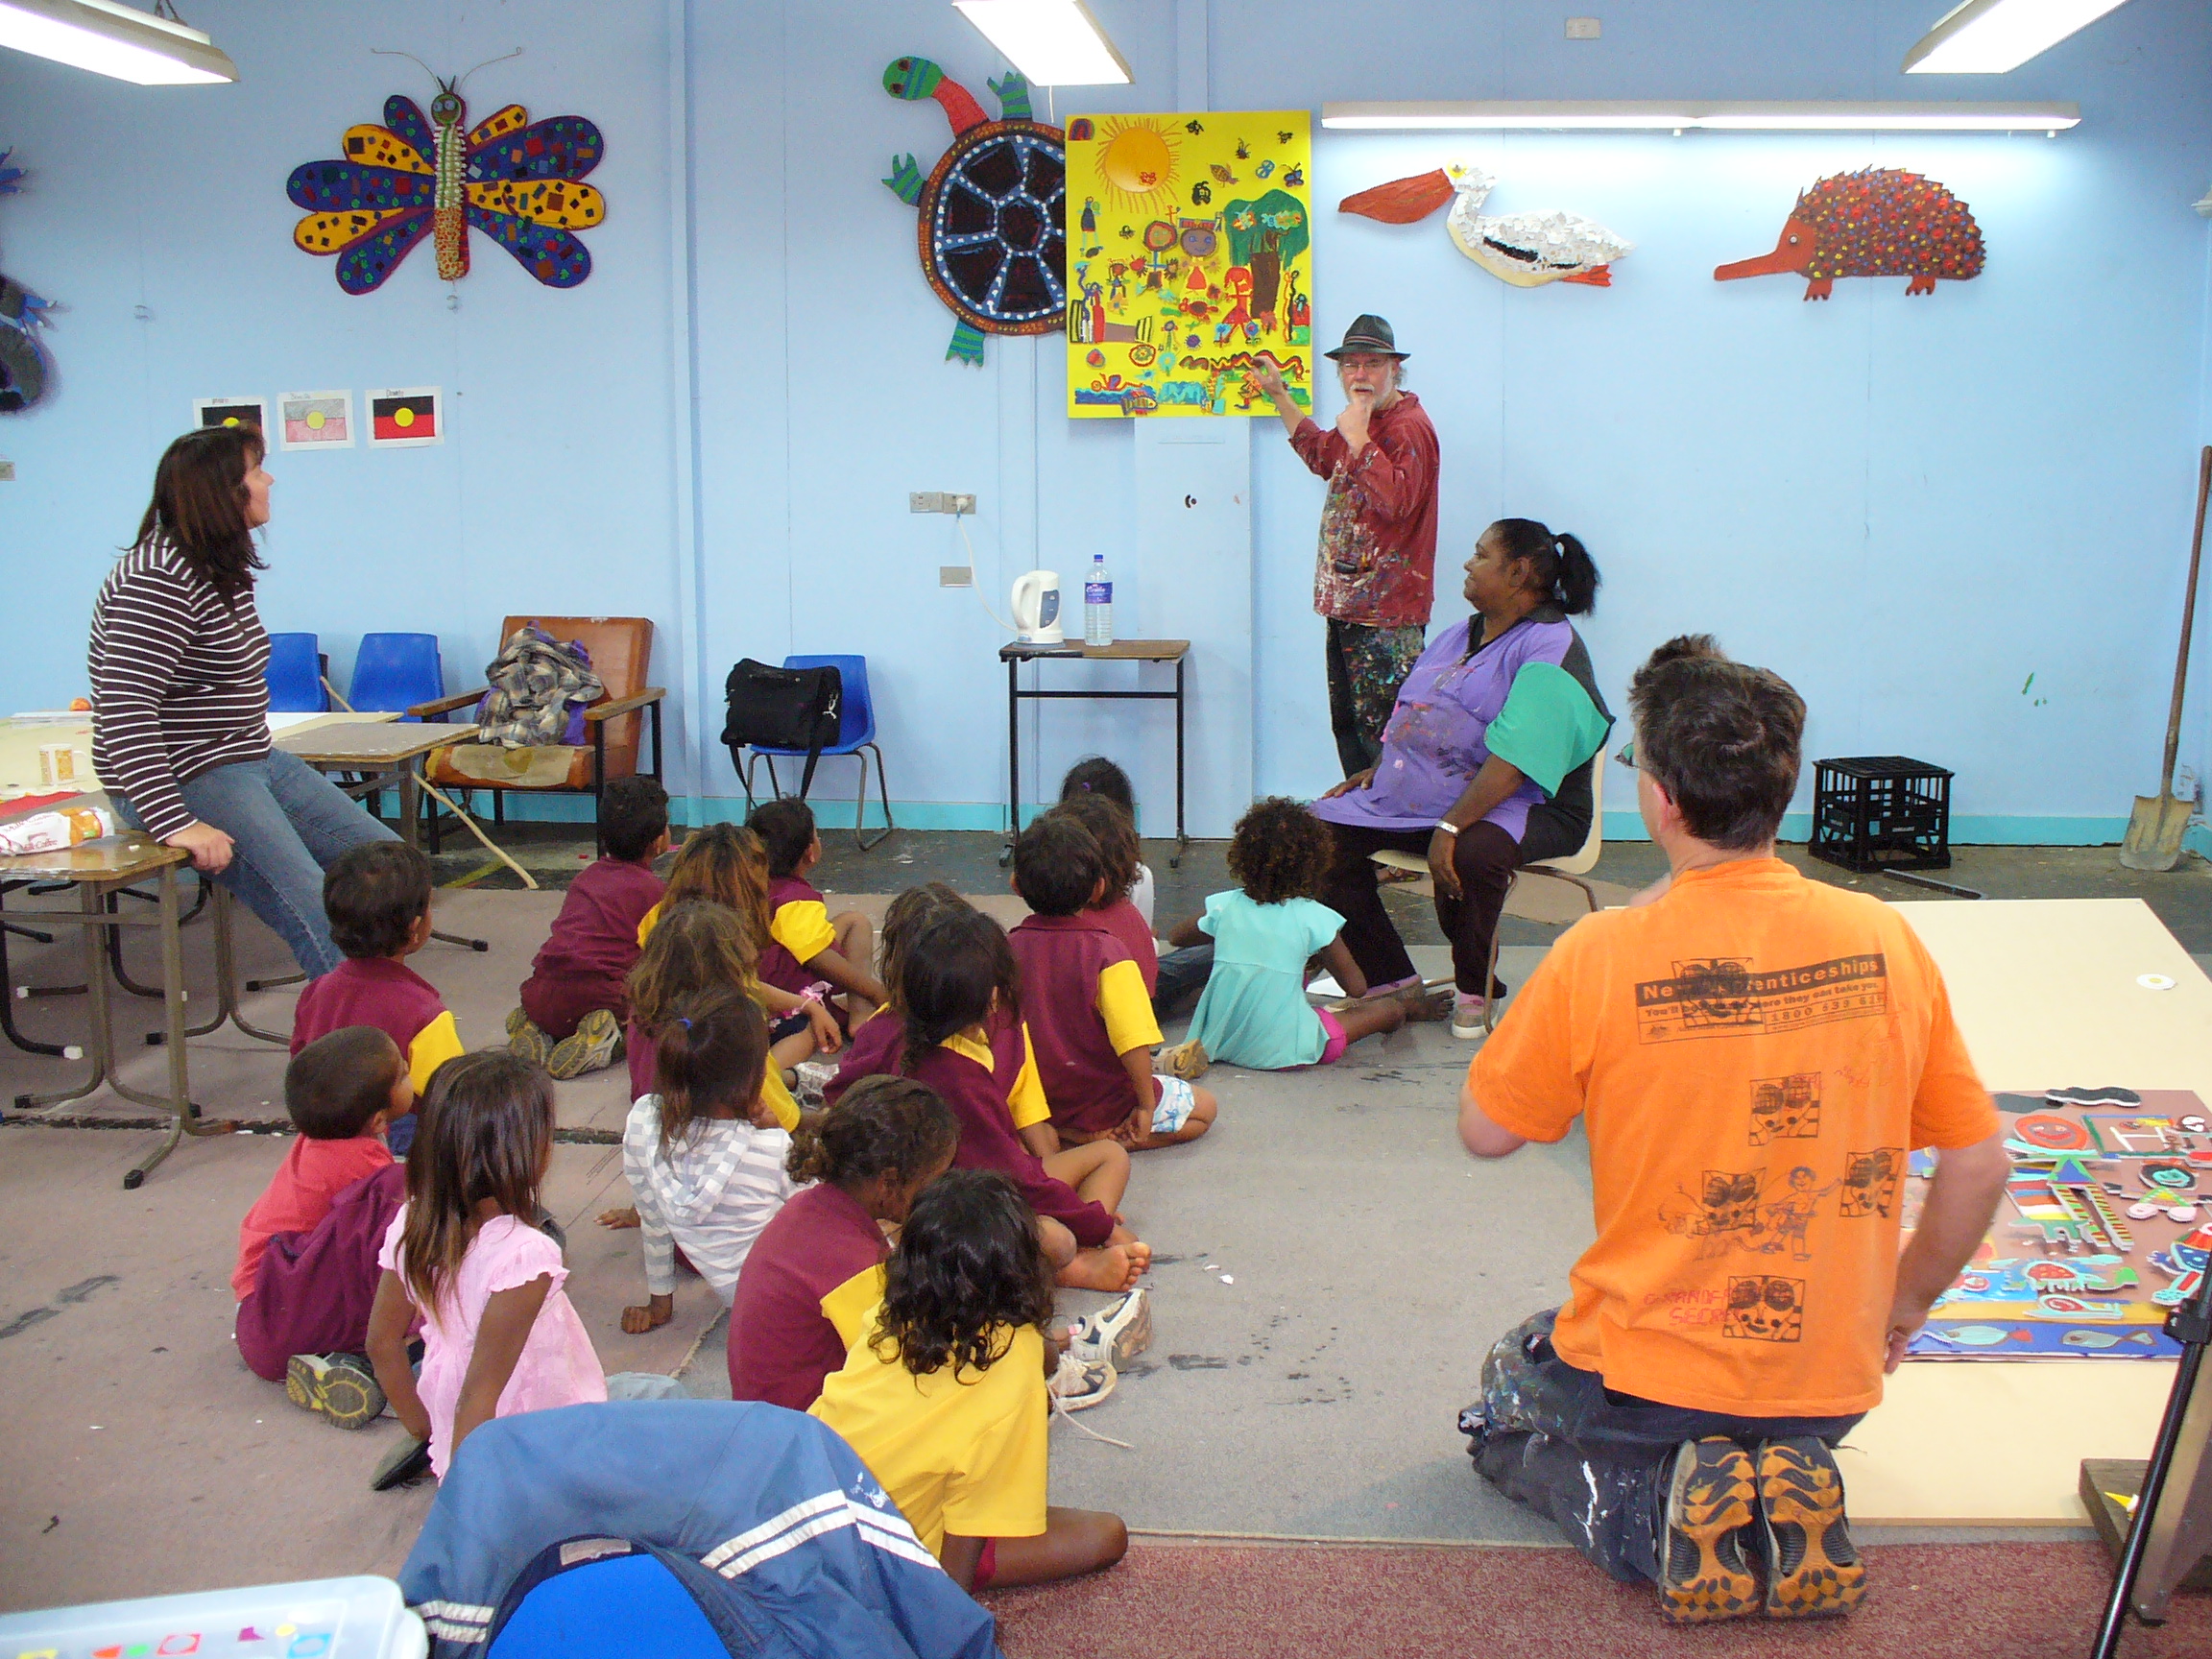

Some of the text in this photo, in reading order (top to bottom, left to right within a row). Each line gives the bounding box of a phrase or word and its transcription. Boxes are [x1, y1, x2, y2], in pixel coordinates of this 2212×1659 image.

[1642, 983, 1688, 1000] Ne
[1784, 995, 1810, 1004] they
[1812, 988, 1833, 998] can
[1835, 983, 1860, 995] take
[1770, 1006, 1814, 1022] 1800
